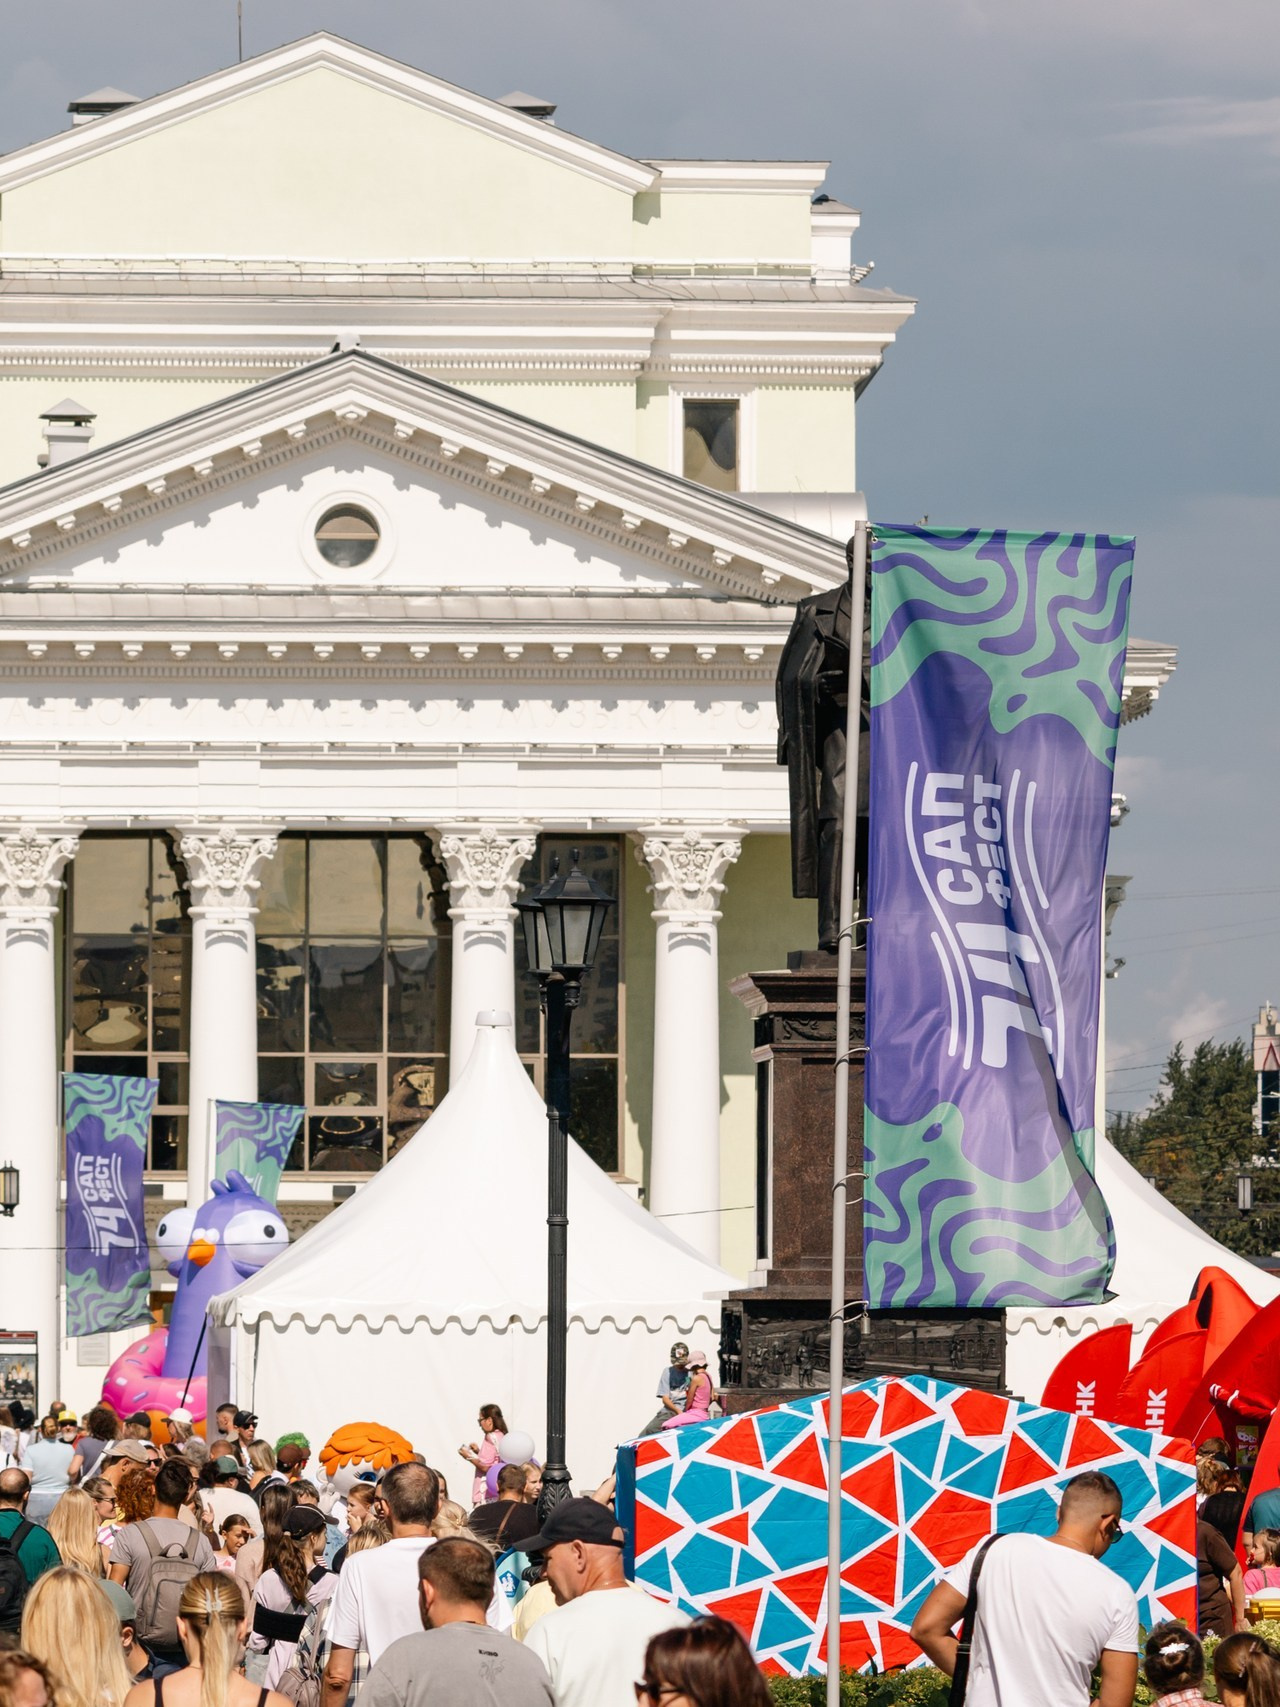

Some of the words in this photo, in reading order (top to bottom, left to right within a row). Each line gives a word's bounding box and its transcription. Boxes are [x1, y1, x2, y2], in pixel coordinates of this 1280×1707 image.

[921, 772, 983, 905] САП
[79, 1155, 99, 1202] САП
[90, 1206, 135, 1256] 74
